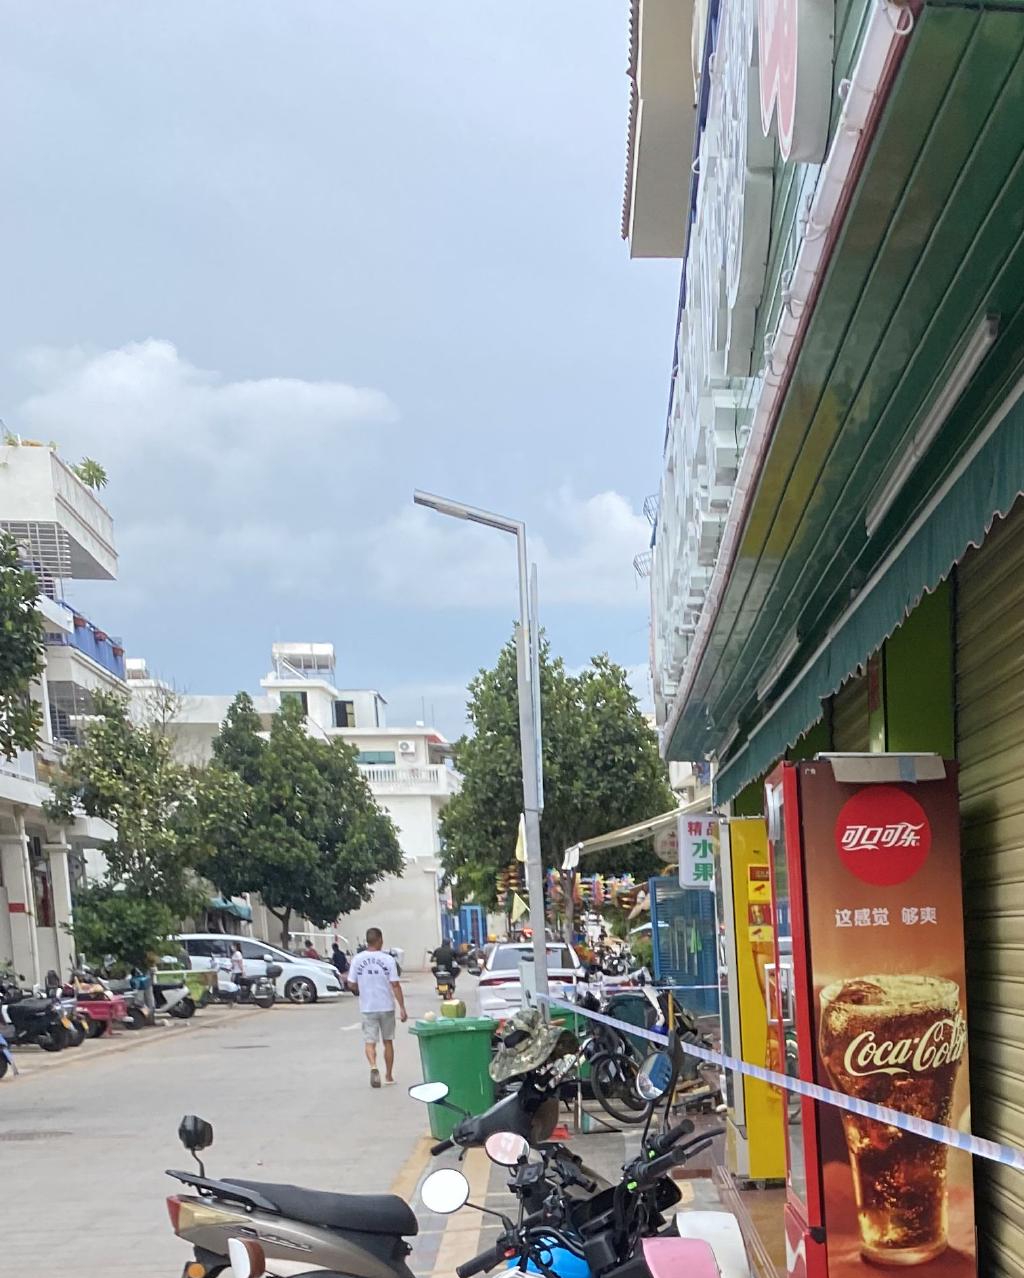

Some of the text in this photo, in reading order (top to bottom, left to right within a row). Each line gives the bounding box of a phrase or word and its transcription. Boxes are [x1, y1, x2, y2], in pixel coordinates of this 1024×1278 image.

[841, 821, 925, 851] 可口可乐
[692, 839, 714, 881] 水果
[835, 907, 938, 928] 这感觉 够爽
